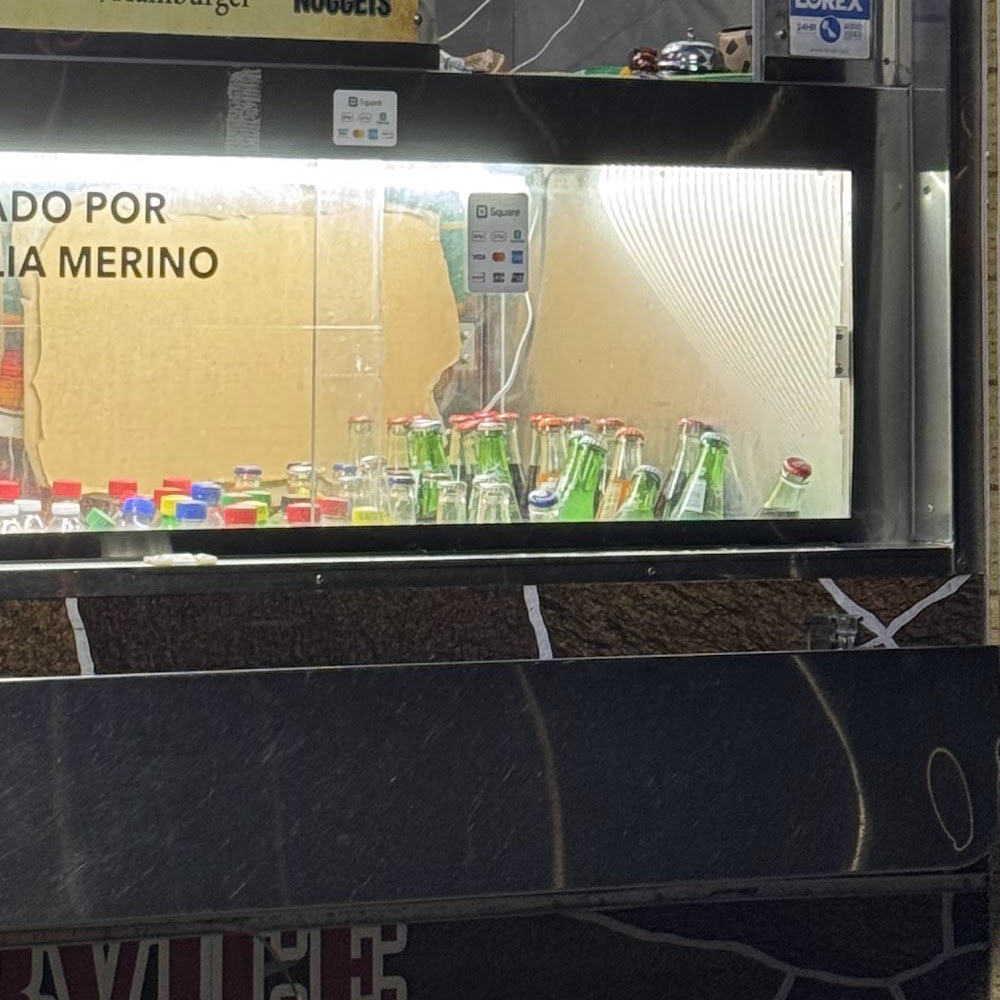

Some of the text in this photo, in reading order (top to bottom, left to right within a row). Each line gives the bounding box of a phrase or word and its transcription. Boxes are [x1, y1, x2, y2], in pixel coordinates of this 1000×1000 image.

[86, 191, 167, 225] POR
[490, 205, 521, 218] Square
[58, 245, 219, 279] MERINO
